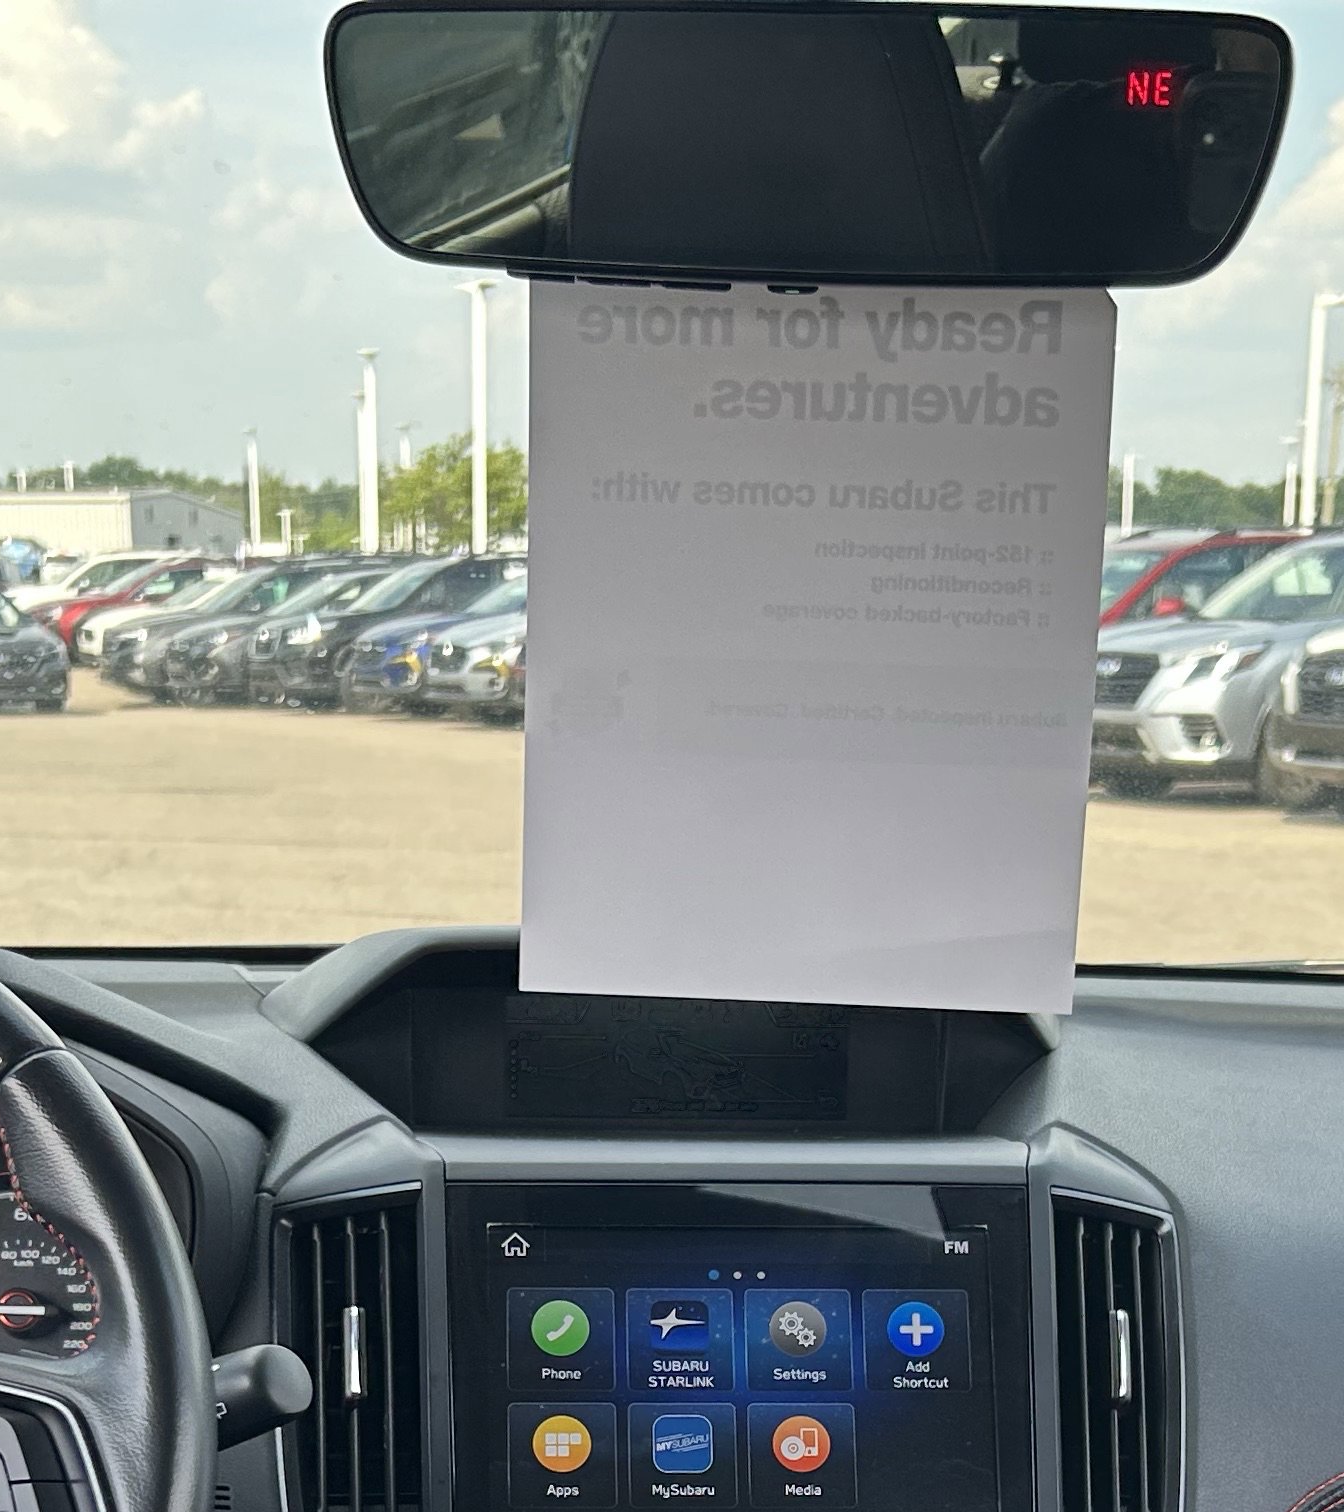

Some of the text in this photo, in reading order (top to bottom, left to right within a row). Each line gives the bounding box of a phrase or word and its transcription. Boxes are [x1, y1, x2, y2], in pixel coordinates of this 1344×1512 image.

[1127, 72, 1172, 107] NE
[20, 1250, 40, 1259] 100
[943, 1240, 970, 1255] FM
[41, 1256, 61, 1265] 120
[57, 1267, 77, 1276] 140
[652, 1359, 710, 1374] SUBARU
[905, 1360, 931, 1374] Add
[541, 1367, 582, 1382] Phone
[648, 1375, 715, 1389] STARLINK
[772, 1367, 827, 1384] Settings
[892, 1375, 950, 1390] Shortcut
[546, 1483, 580, 1500] Apps
[651, 1483, 716, 1499] MySubaru
[784, 1483, 822, 1497] Media
